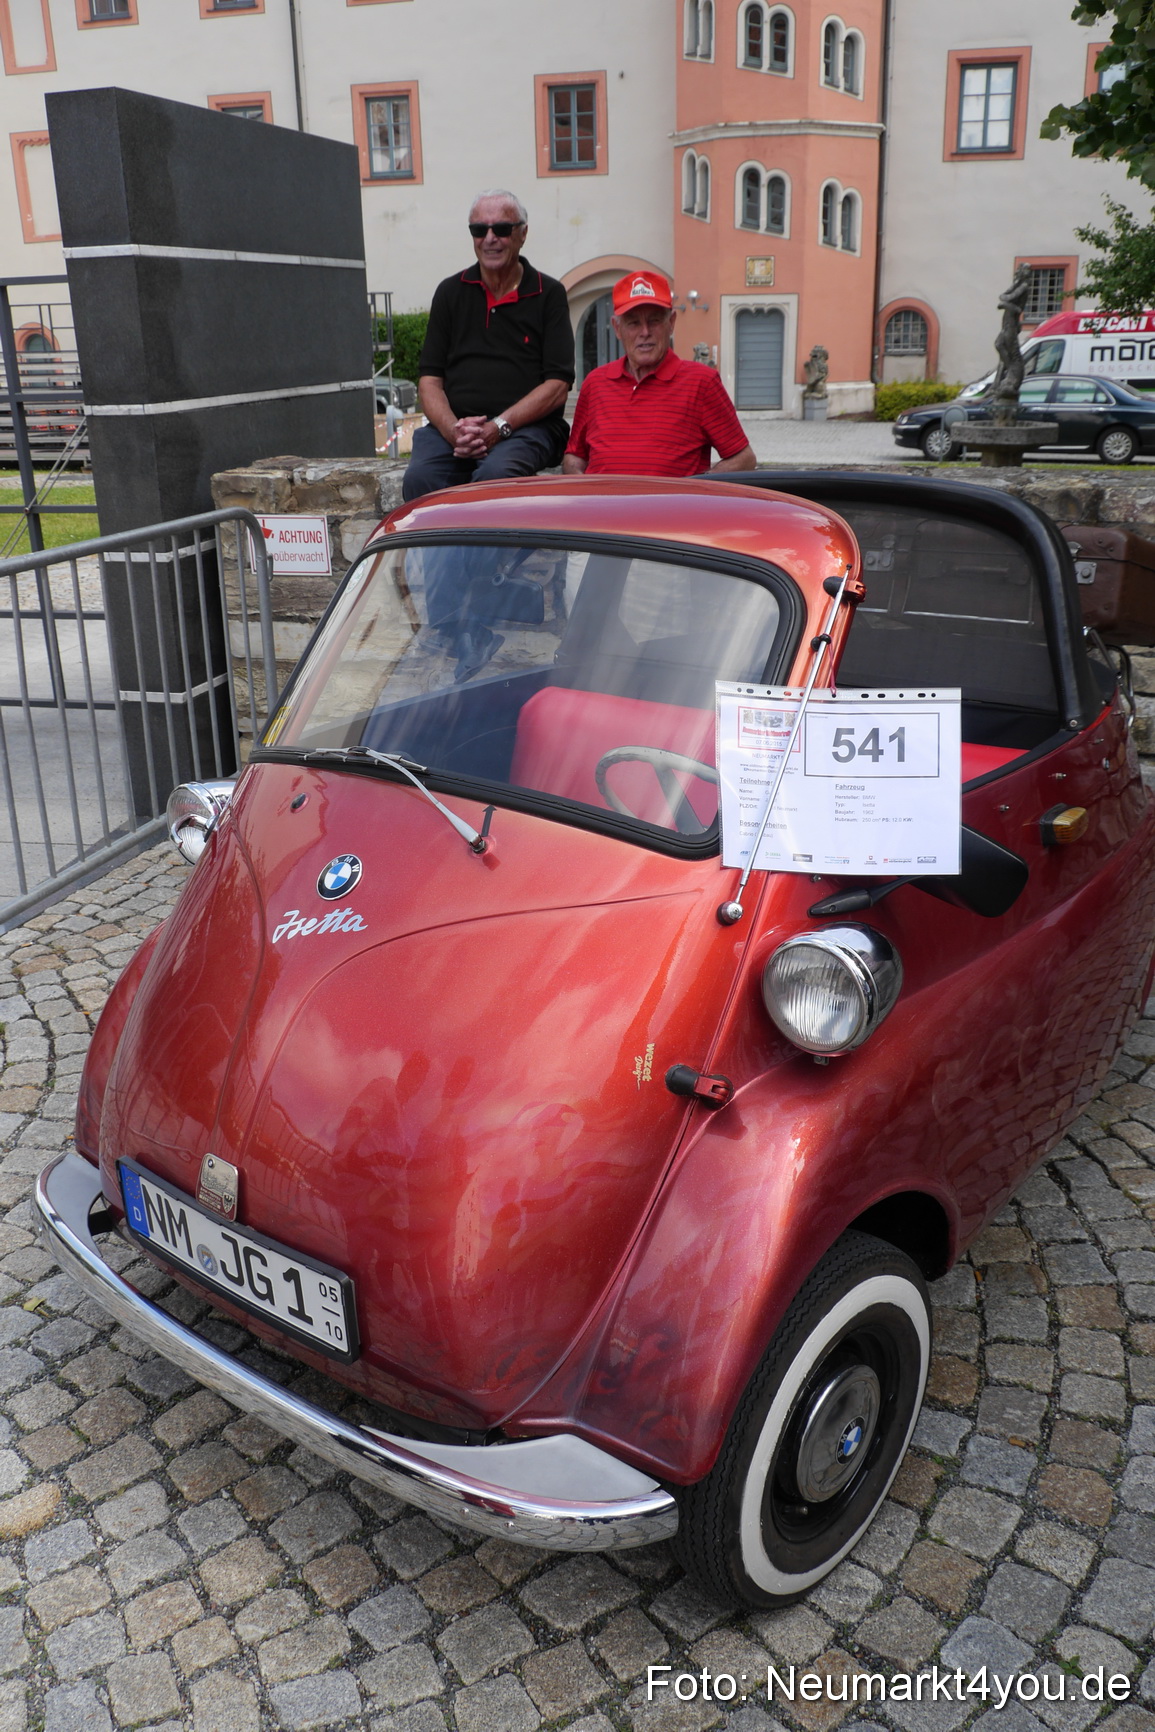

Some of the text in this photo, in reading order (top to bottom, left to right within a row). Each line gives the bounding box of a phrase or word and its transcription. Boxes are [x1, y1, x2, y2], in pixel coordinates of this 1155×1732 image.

[278, 530, 323, 544] ACHTUNG
[272, 551, 325, 562] oüberwacht
[832, 726, 906, 763] 541
[835, 783, 866, 791] Fahrzeug
[331, 856, 360, 873] BMW
[272, 907, 369, 944] Isetta
[133, 1206, 142, 1222] D
[141, 1183, 194, 1259] NM
[318, 1281, 339, 1303] 05
[325, 1321, 343, 1341] 10
